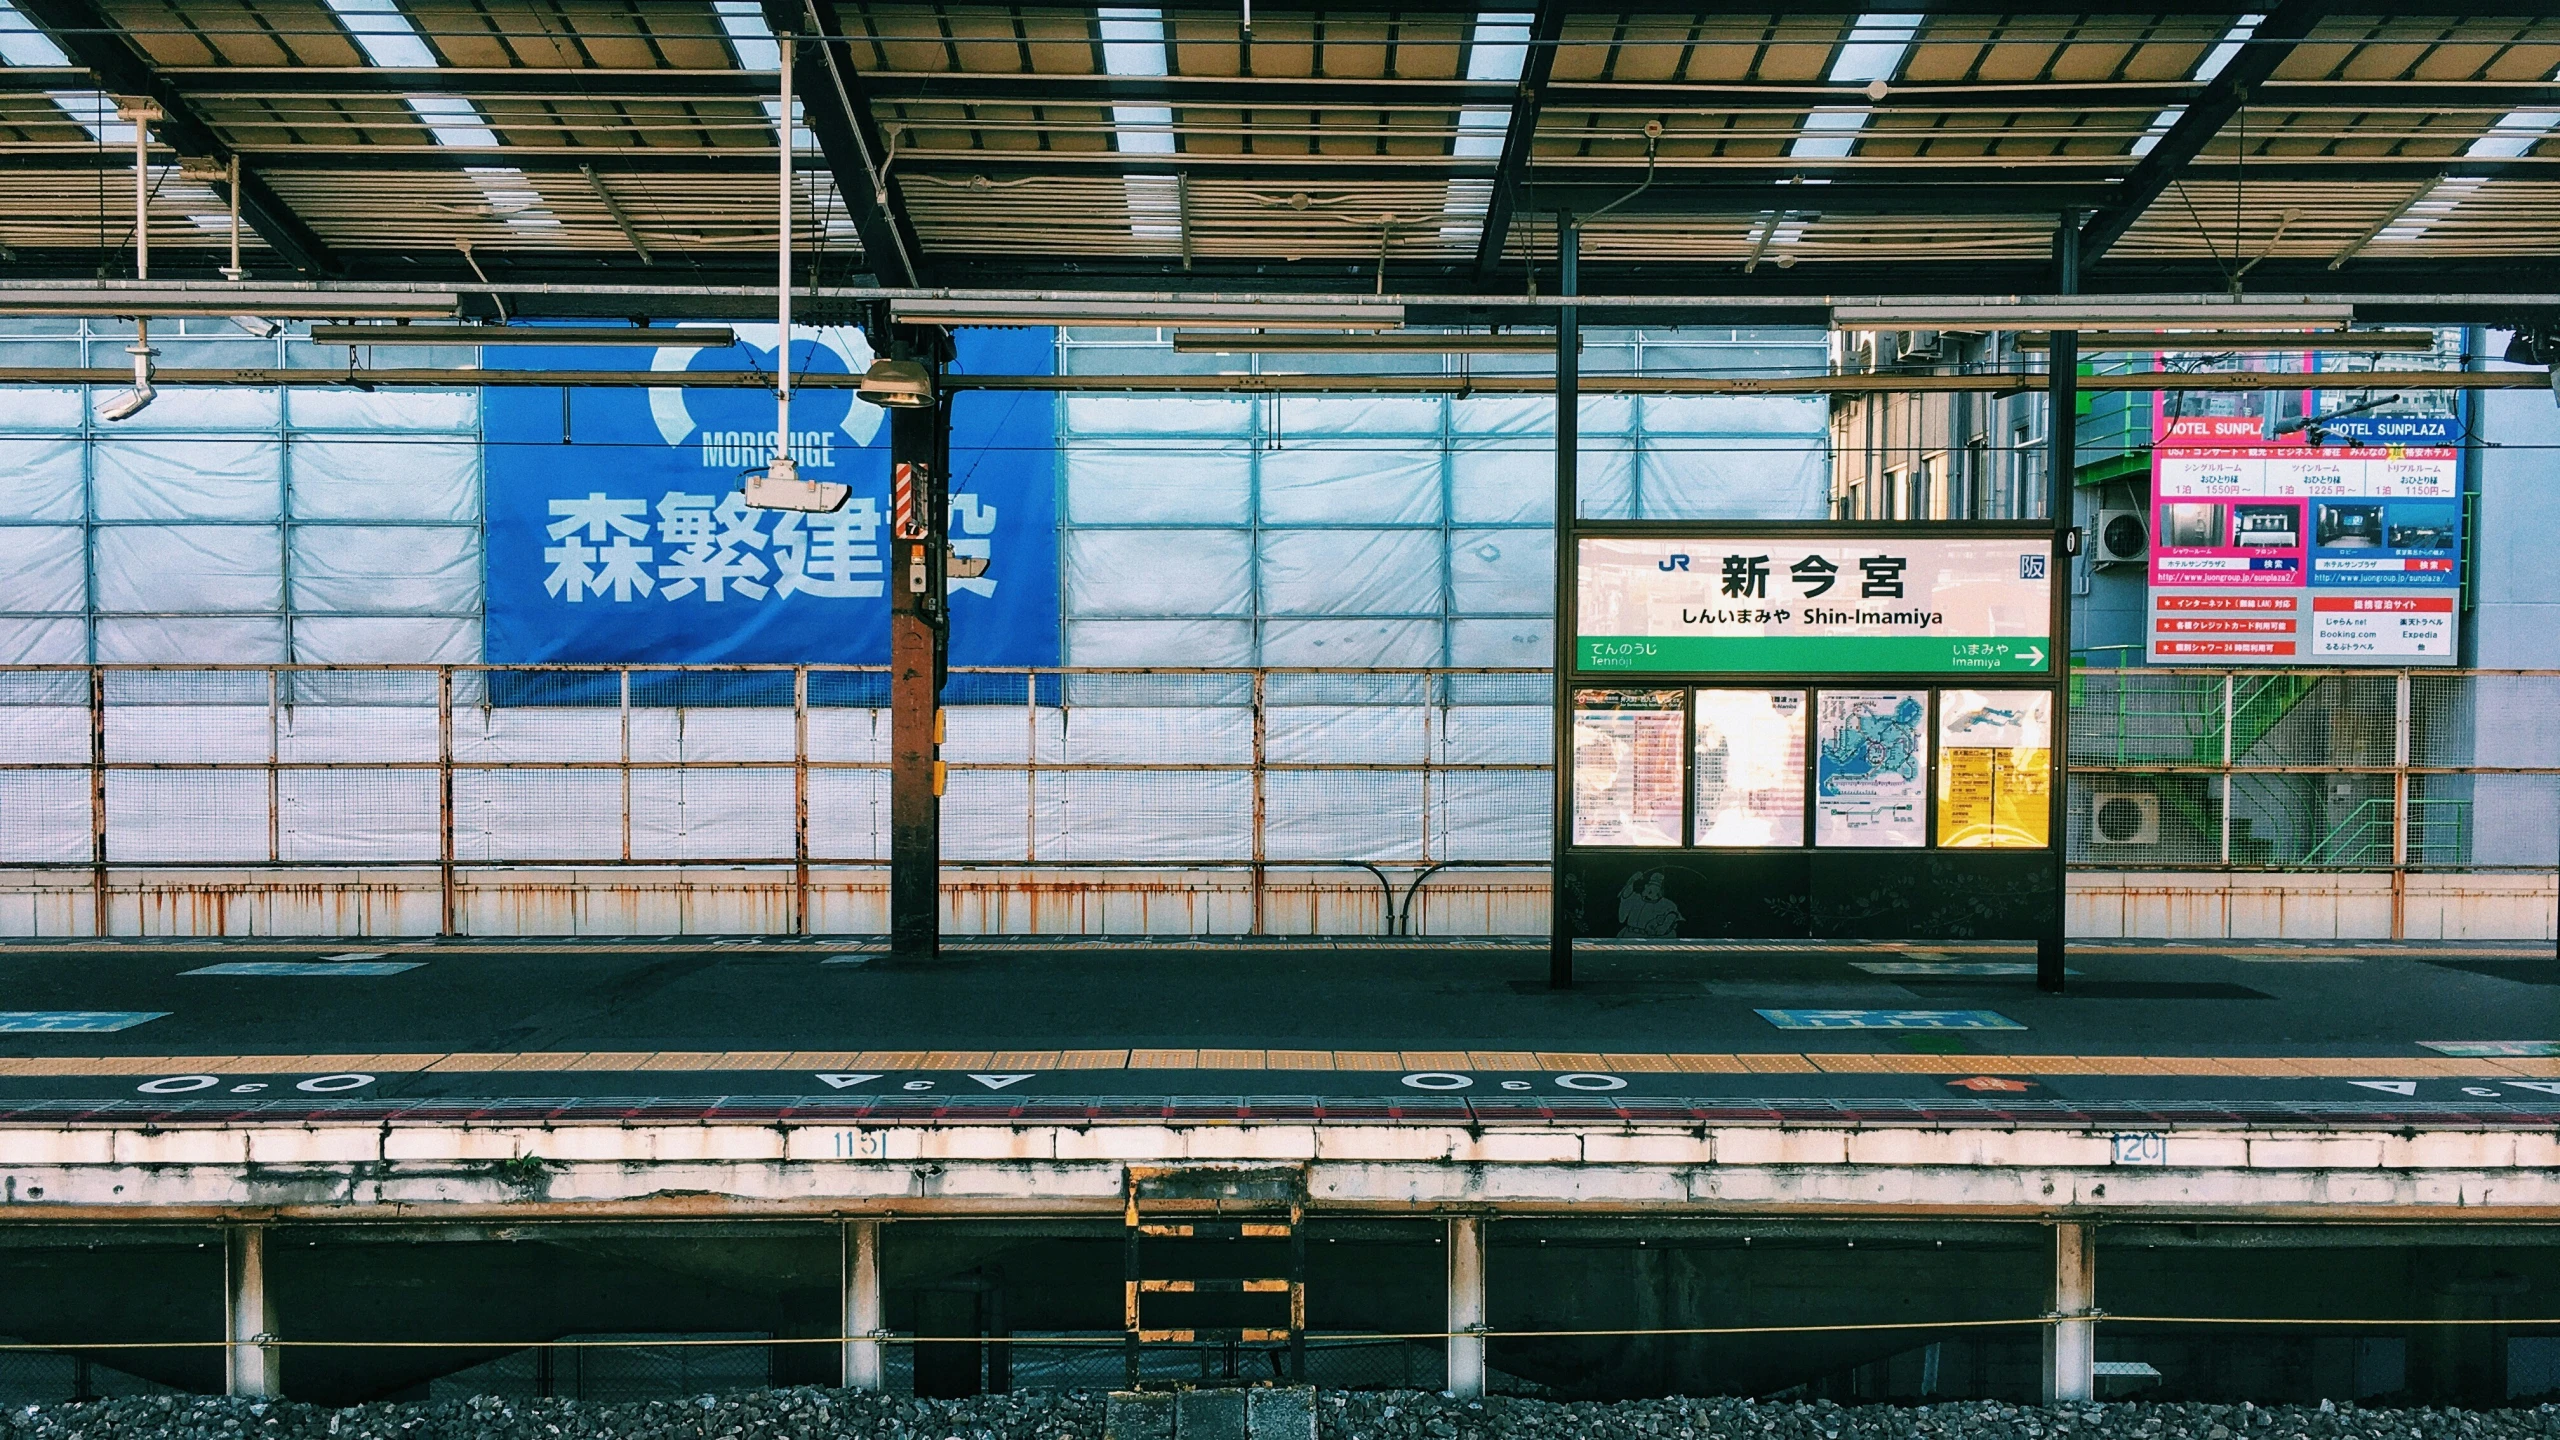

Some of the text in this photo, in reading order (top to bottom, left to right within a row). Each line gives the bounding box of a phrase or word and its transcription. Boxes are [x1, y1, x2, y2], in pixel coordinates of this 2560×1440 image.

[2167, 422, 2210, 435] HOTEL
[2330, 423, 2446, 436] HOTEL SUNPLAZA
[2184, 463, 2242, 473] シングルルーム
[2292, 463, 2340, 473] ツインルーム
[2387, 463, 2441, 473] トリプルルーム
[2200, 475, 2239, 484] おひとり様
[2304, 475, 2341, 485] おひとり様
[2400, 475, 2438, 485] おひとり様
[908, 522, 917, 535] 7
[1658, 553, 1690, 572] JR
[2021, 555, 2045, 578] 阪
[2263, 559, 2284, 569] 検索
[2419, 560, 2439, 570] 検索
[1720, 553, 1907, 600] 新今宮
[2314, 573, 2446, 583] http://www.juongroup.jp/sunplaza/
[1682, 607, 1943, 629] しんいまみや Shin-Imamiya
[2399, 618, 2443, 626] 楽天トラベル
[2320, 630, 2377, 639] Booking.com
[2402, 630, 2438, 639] Expedia
[1590, 643, 1658, 656] てんのうじ
[1952, 643, 2009, 656] いまみや
[1952, 656, 2001, 670] Imamiya
